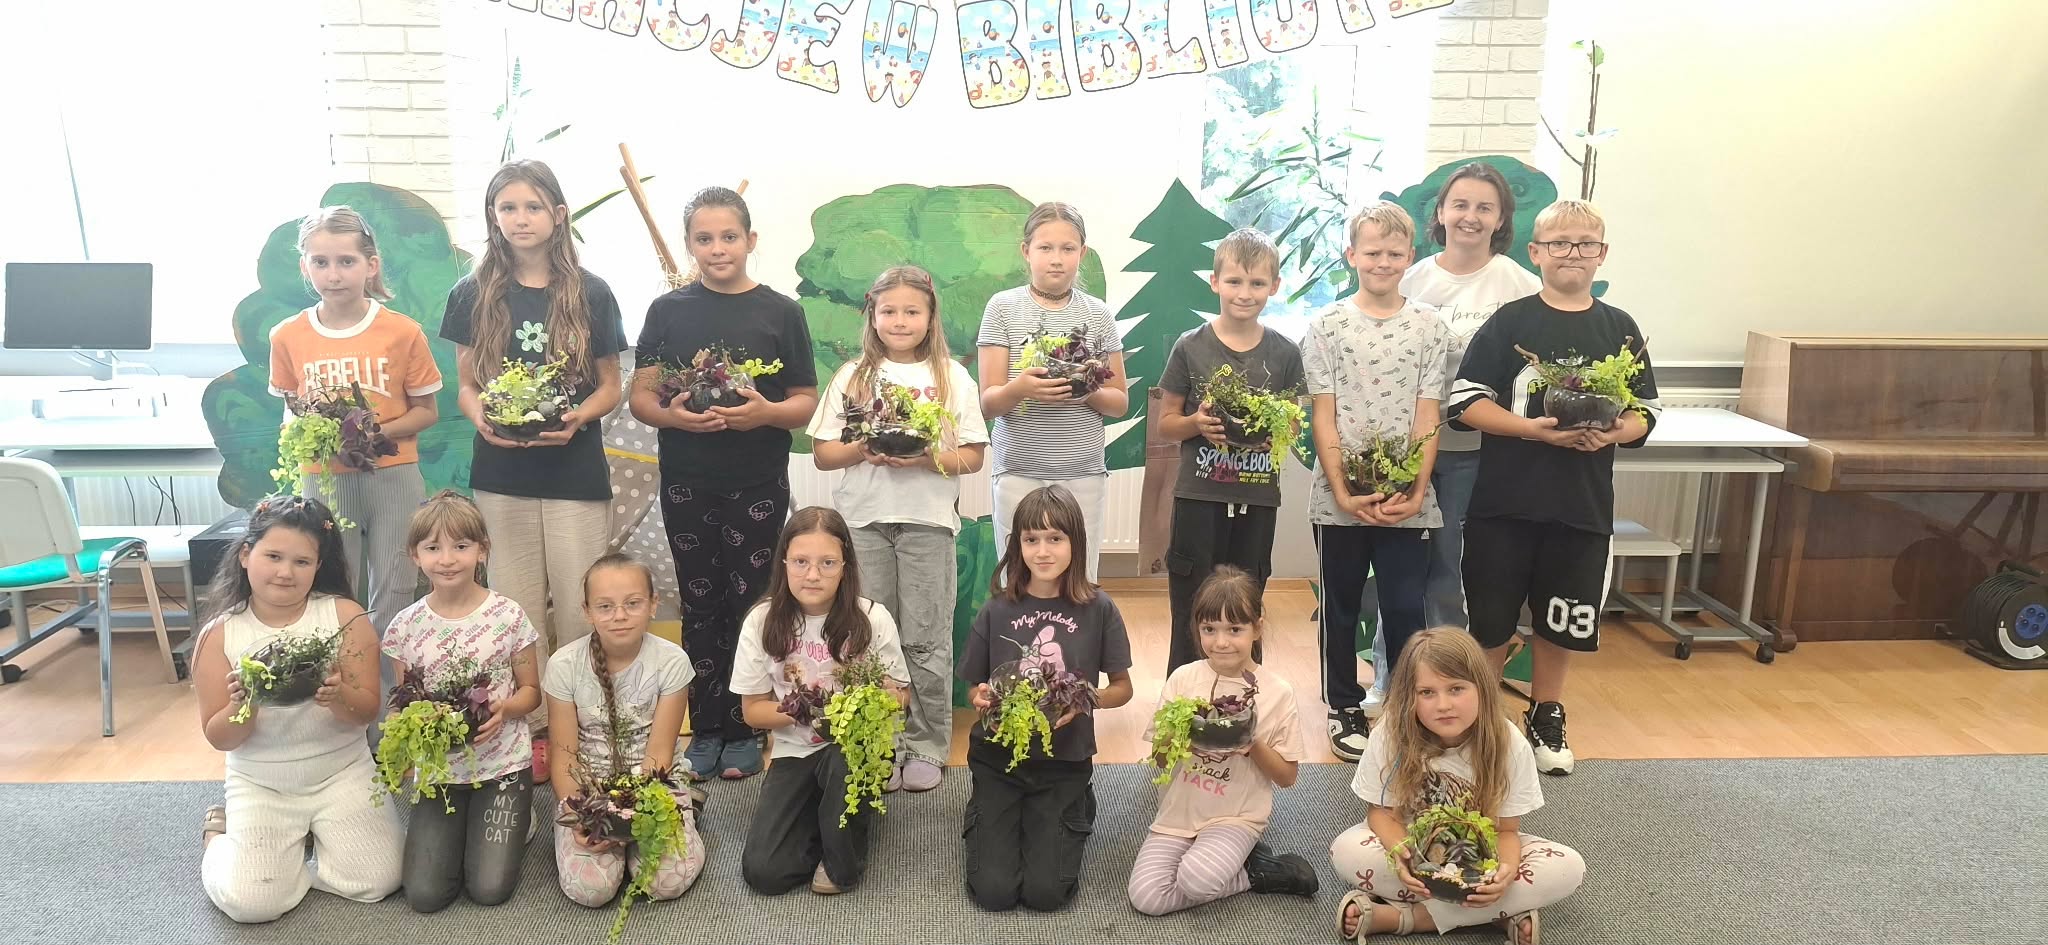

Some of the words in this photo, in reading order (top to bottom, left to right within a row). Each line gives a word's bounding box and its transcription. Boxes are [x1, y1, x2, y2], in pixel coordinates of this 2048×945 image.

[862, 0, 939, 108] W
[303, 357, 390, 393] REBELLE
[1196, 446, 1273, 472] SPONGEBOB
[1011, 614, 1037, 631] My
[1035, 610, 1079, 633] Melody
[1547, 596, 1596, 639] 03
[464, 624, 492, 646] POWER
[1192, 763, 1231, 782] sack
[493, 795, 517, 809] MY
[483, 809, 518, 826] CUTE
[485, 826, 512, 844] CAT
